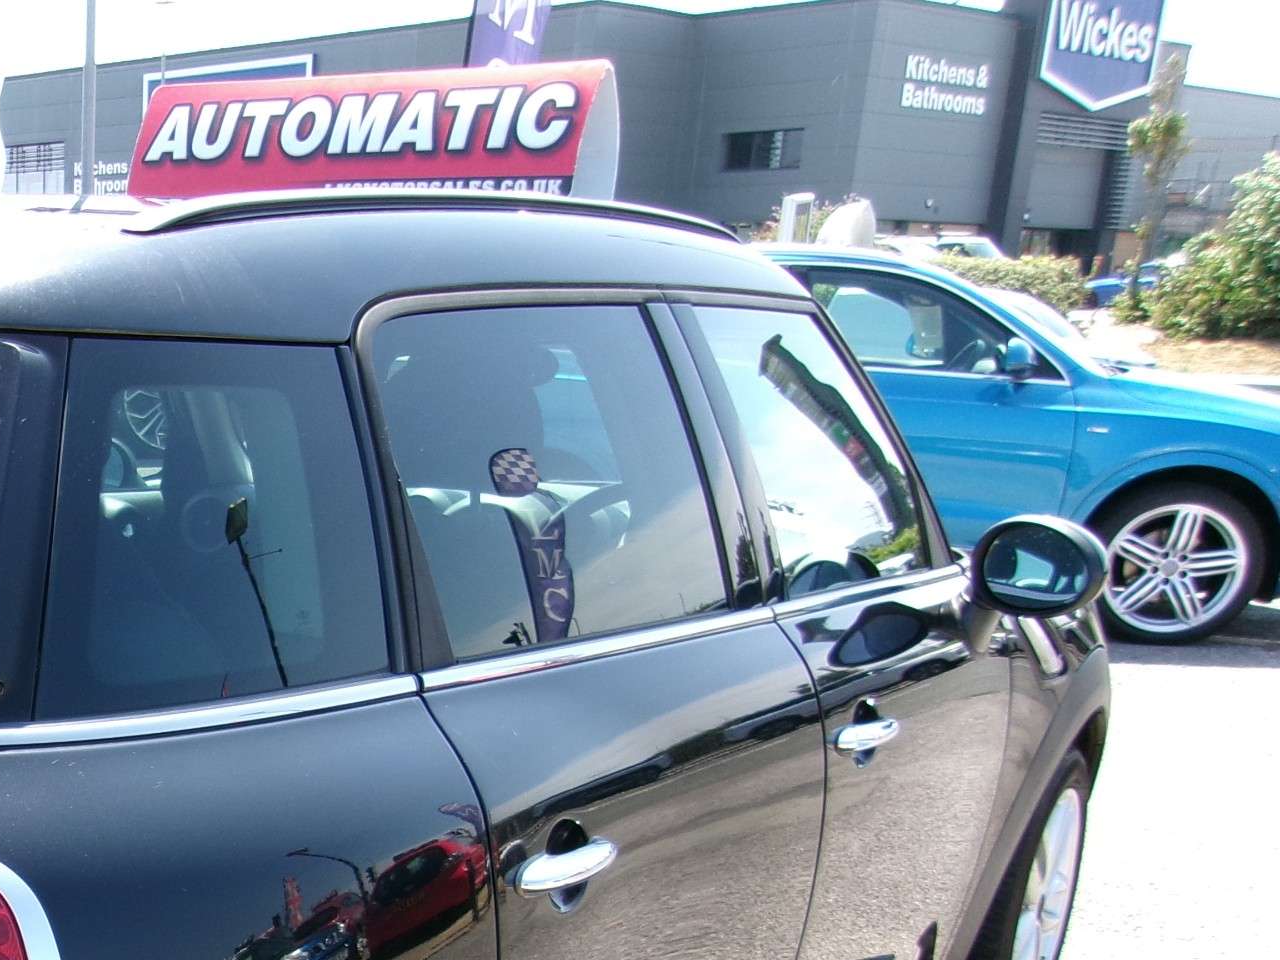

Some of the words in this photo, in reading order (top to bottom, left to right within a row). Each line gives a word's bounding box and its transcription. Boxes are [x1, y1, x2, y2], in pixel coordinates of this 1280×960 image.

[1058, 0, 1155, 63] Wickes
[905, 54, 977, 87] Kitchens
[976, 64, 989, 89] &
[901, 82, 985, 115] Bathrooms
[143, 81, 578, 162] AUTOMATIC
[73, 160, 128, 177] Kchens
